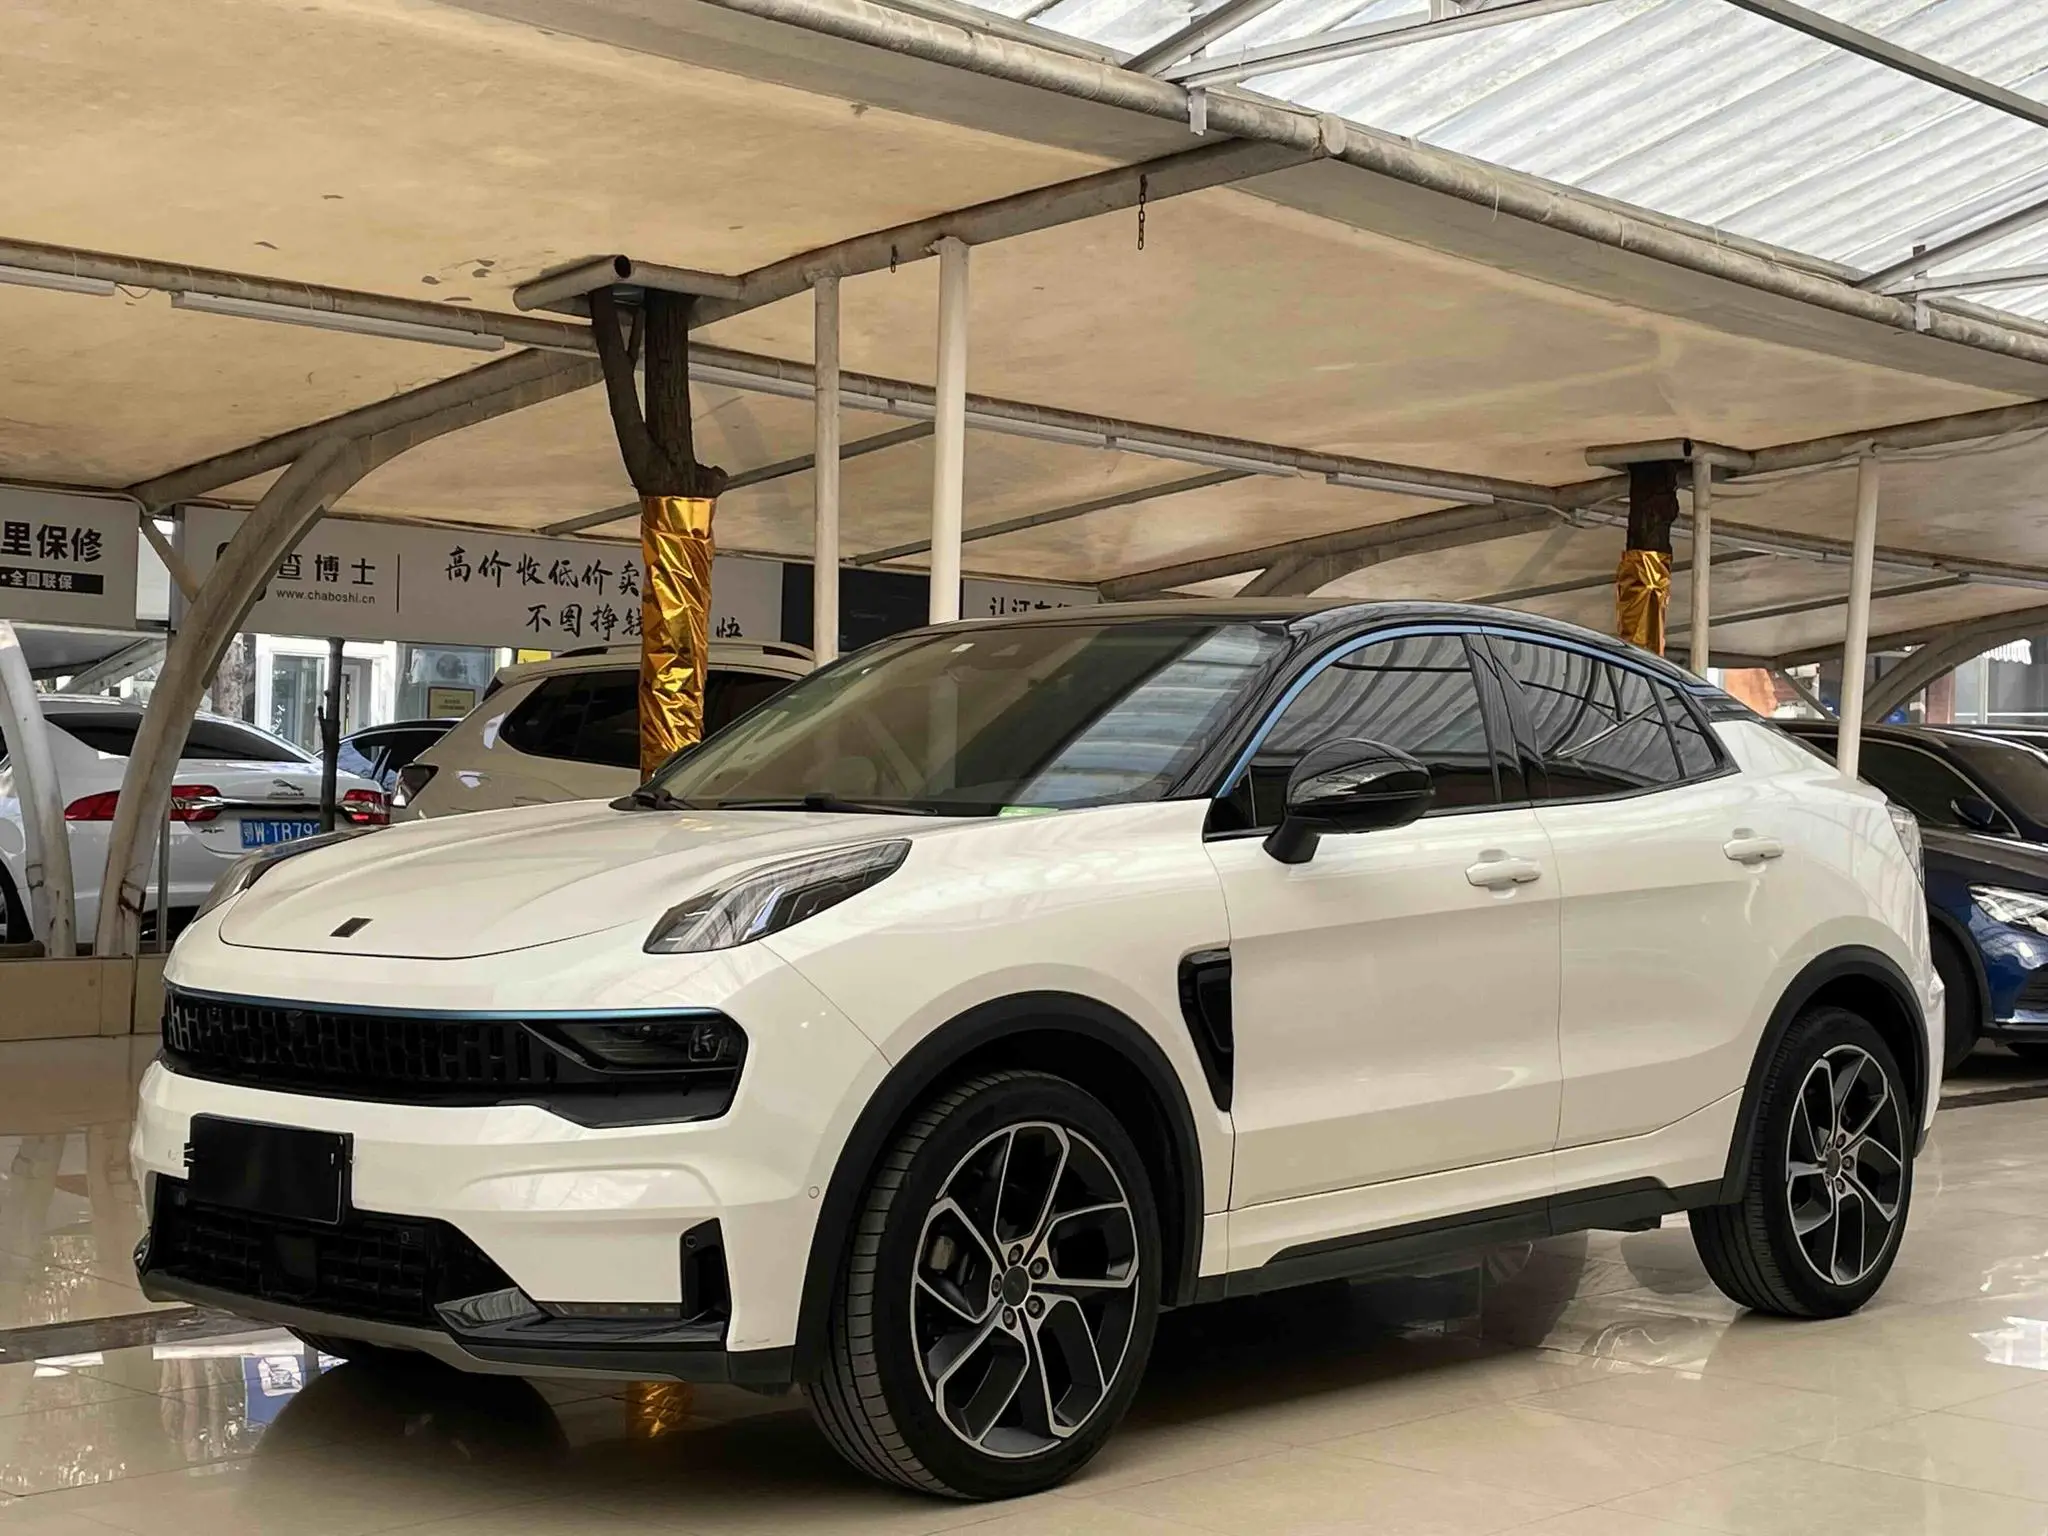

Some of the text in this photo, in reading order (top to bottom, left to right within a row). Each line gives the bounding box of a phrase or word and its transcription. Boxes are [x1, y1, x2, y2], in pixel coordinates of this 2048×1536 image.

[0, 520, 103, 563] 里保修
[276, 553, 376, 586] 查博士
[444, 545, 641, 597] 高价收低价卖
[276, 589, 376, 605] www.chaboshi.cn
